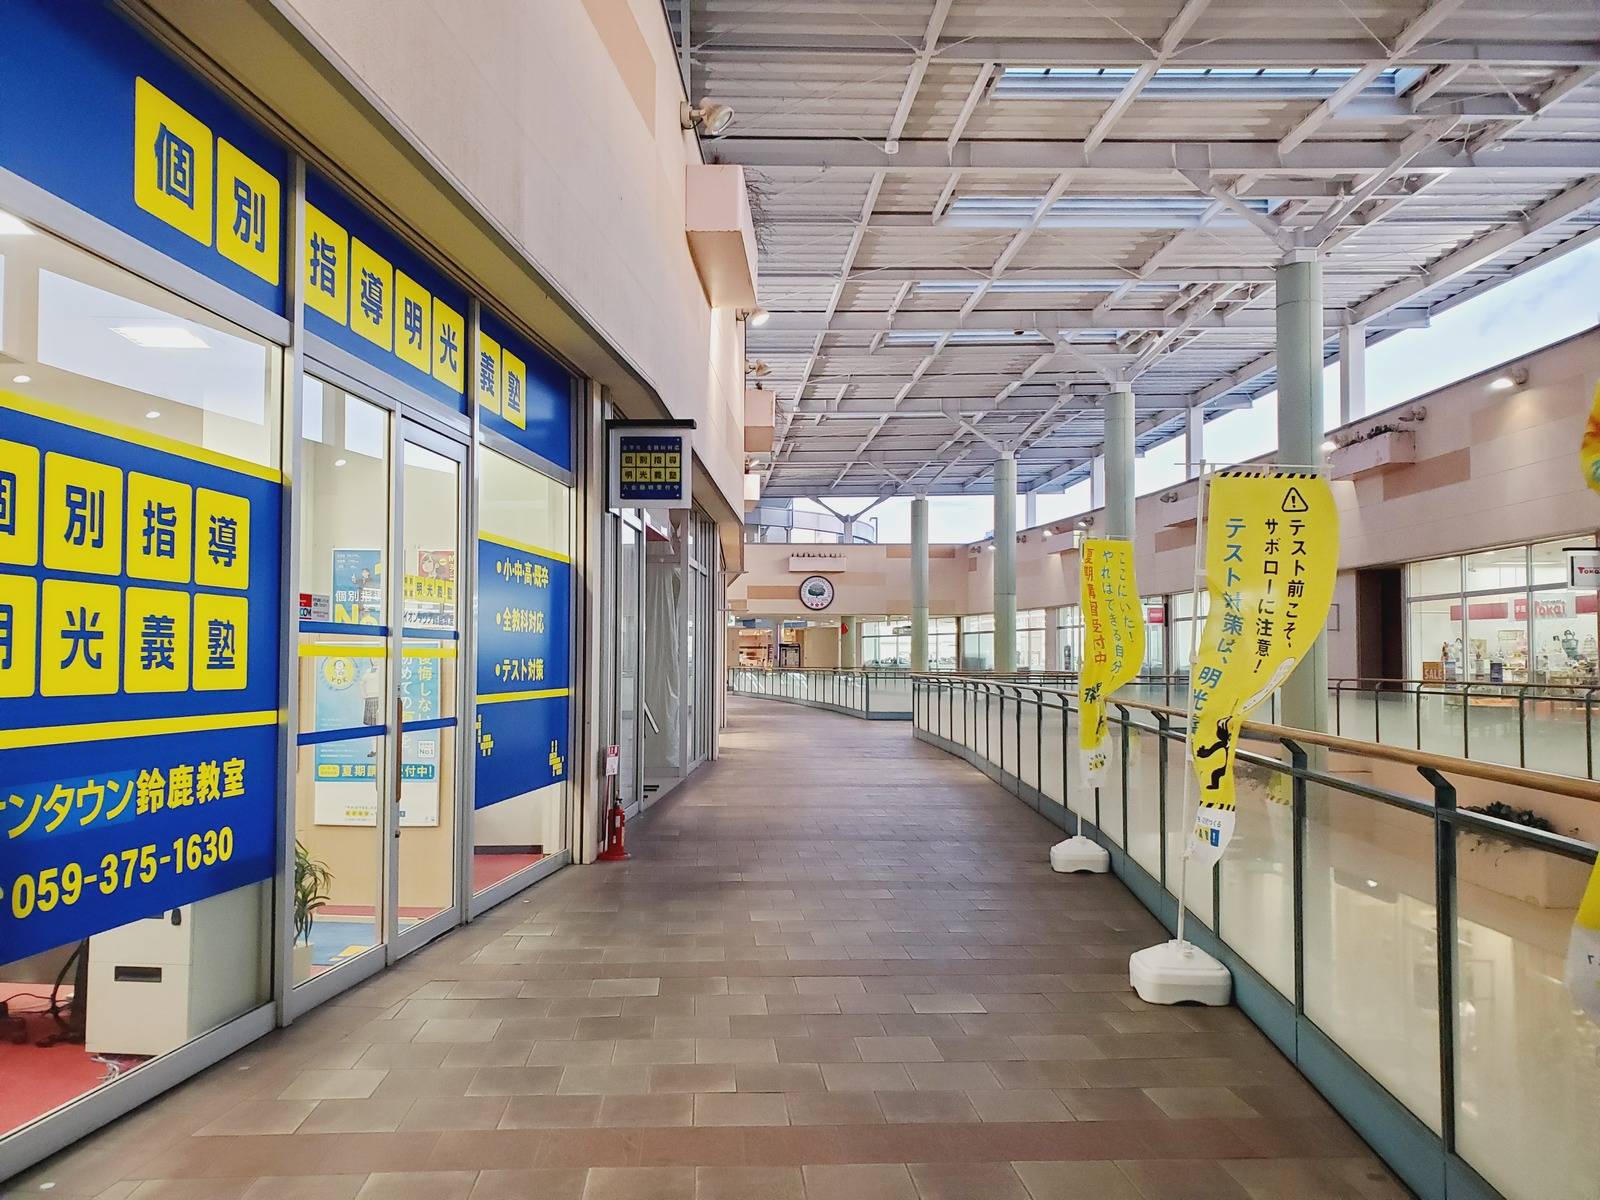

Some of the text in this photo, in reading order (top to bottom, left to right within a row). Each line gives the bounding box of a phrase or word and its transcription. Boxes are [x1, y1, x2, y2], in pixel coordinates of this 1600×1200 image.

[502, 606, 545, 633] 全教科対応
[1253, 517, 1281, 674] サボローに注意!
[1283, 518, 1307, 649] テスト前こそ、
[502, 659, 544, 682] テスト対策
[0, 757, 246, 839] ンタウン鈴鹿教室
[11, 826, 234, 919] 059-375-1630
